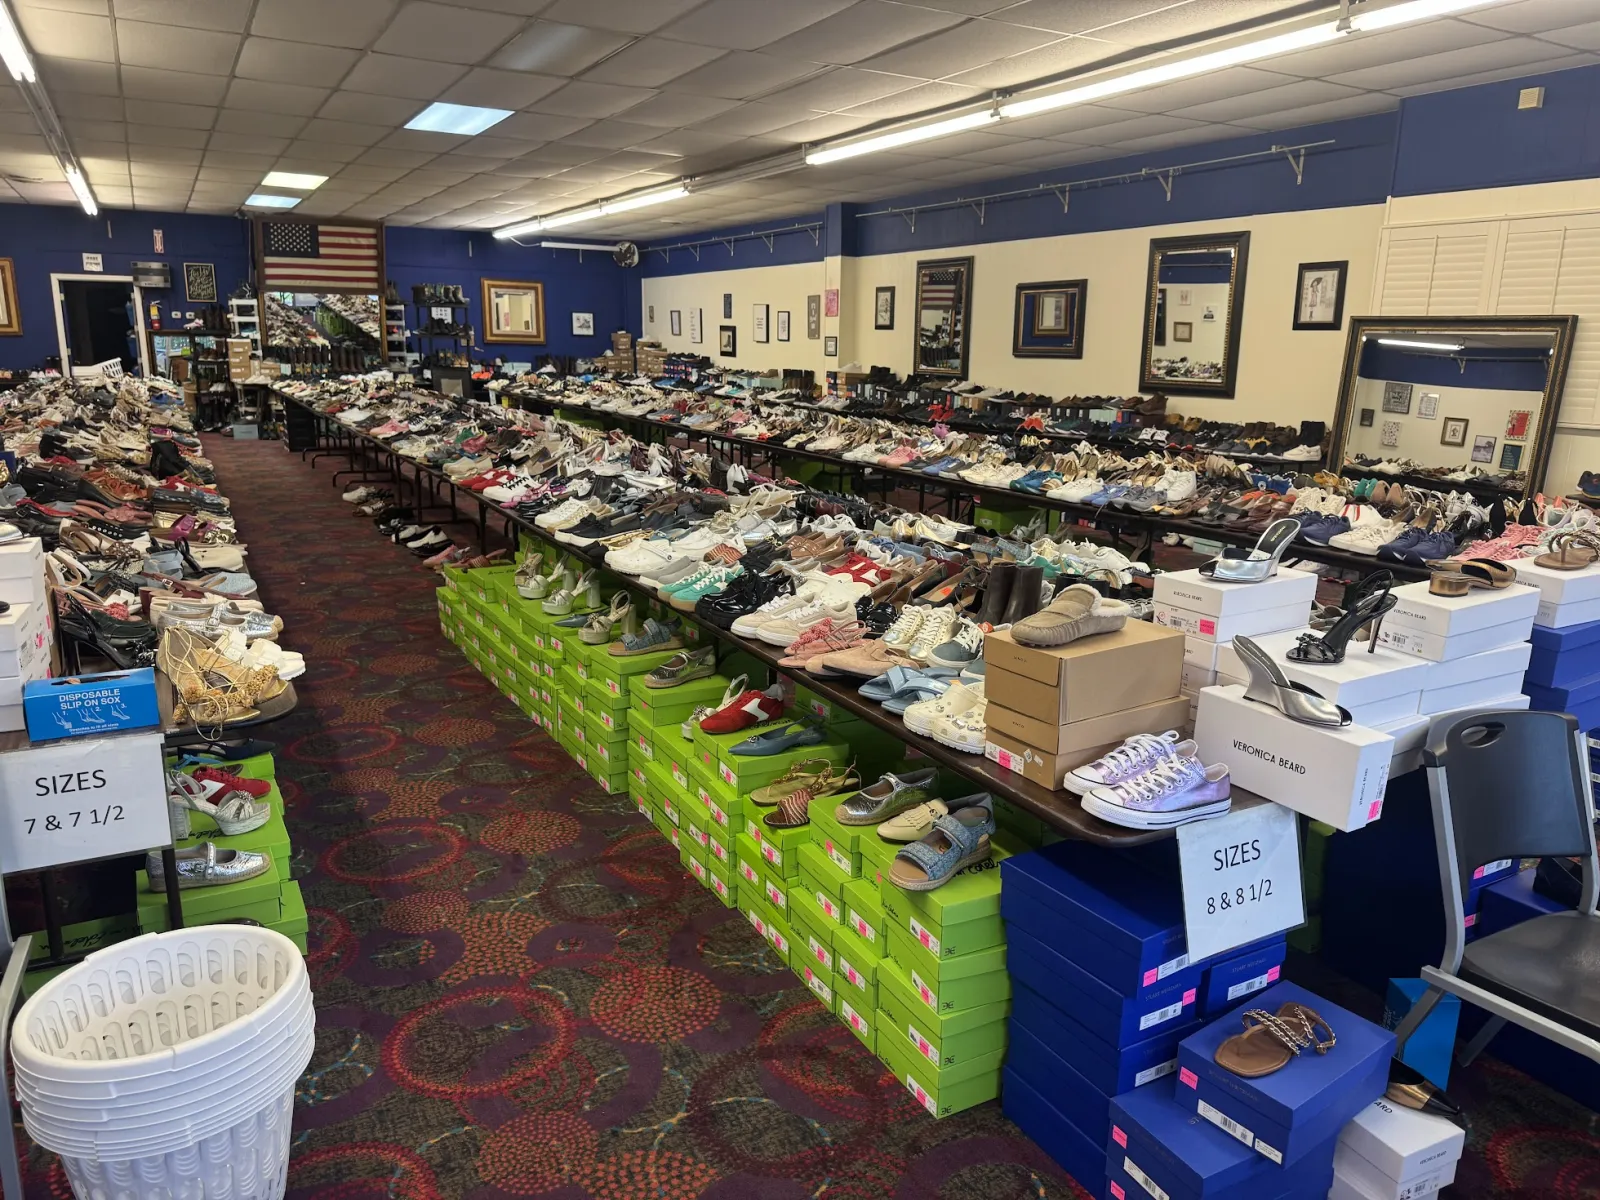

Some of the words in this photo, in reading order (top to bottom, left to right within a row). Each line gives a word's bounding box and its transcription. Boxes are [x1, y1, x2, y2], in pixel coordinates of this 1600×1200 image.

[1393, 608, 1414, 617] VERONICA
[1414, 612, 1427, 620] BEARD
[59, 688, 120, 702] DISPOSABLE
[60, 701, 82, 710] SLIP
[84, 699, 99, 707] ON
[100, 696, 121, 705] SOX
[1233, 739, 1276, 764] VERONICA
[1278, 757, 1306, 775] BEARD
[35, 769, 107, 797] SIZES
[23, 818, 36, 834] 7
[45, 815, 62, 831] &
[68, 811, 81, 827] 7
[89, 804, 125, 826] 1/2
[1213, 839, 1261, 871] SIZES
[1206, 897, 1216, 915] 8
[1220, 891, 1232, 910] &
[1236, 887, 1245, 905] 8
[1249, 878, 1273, 902] 1/2
[1373, 1099, 1394, 1114] ARD
